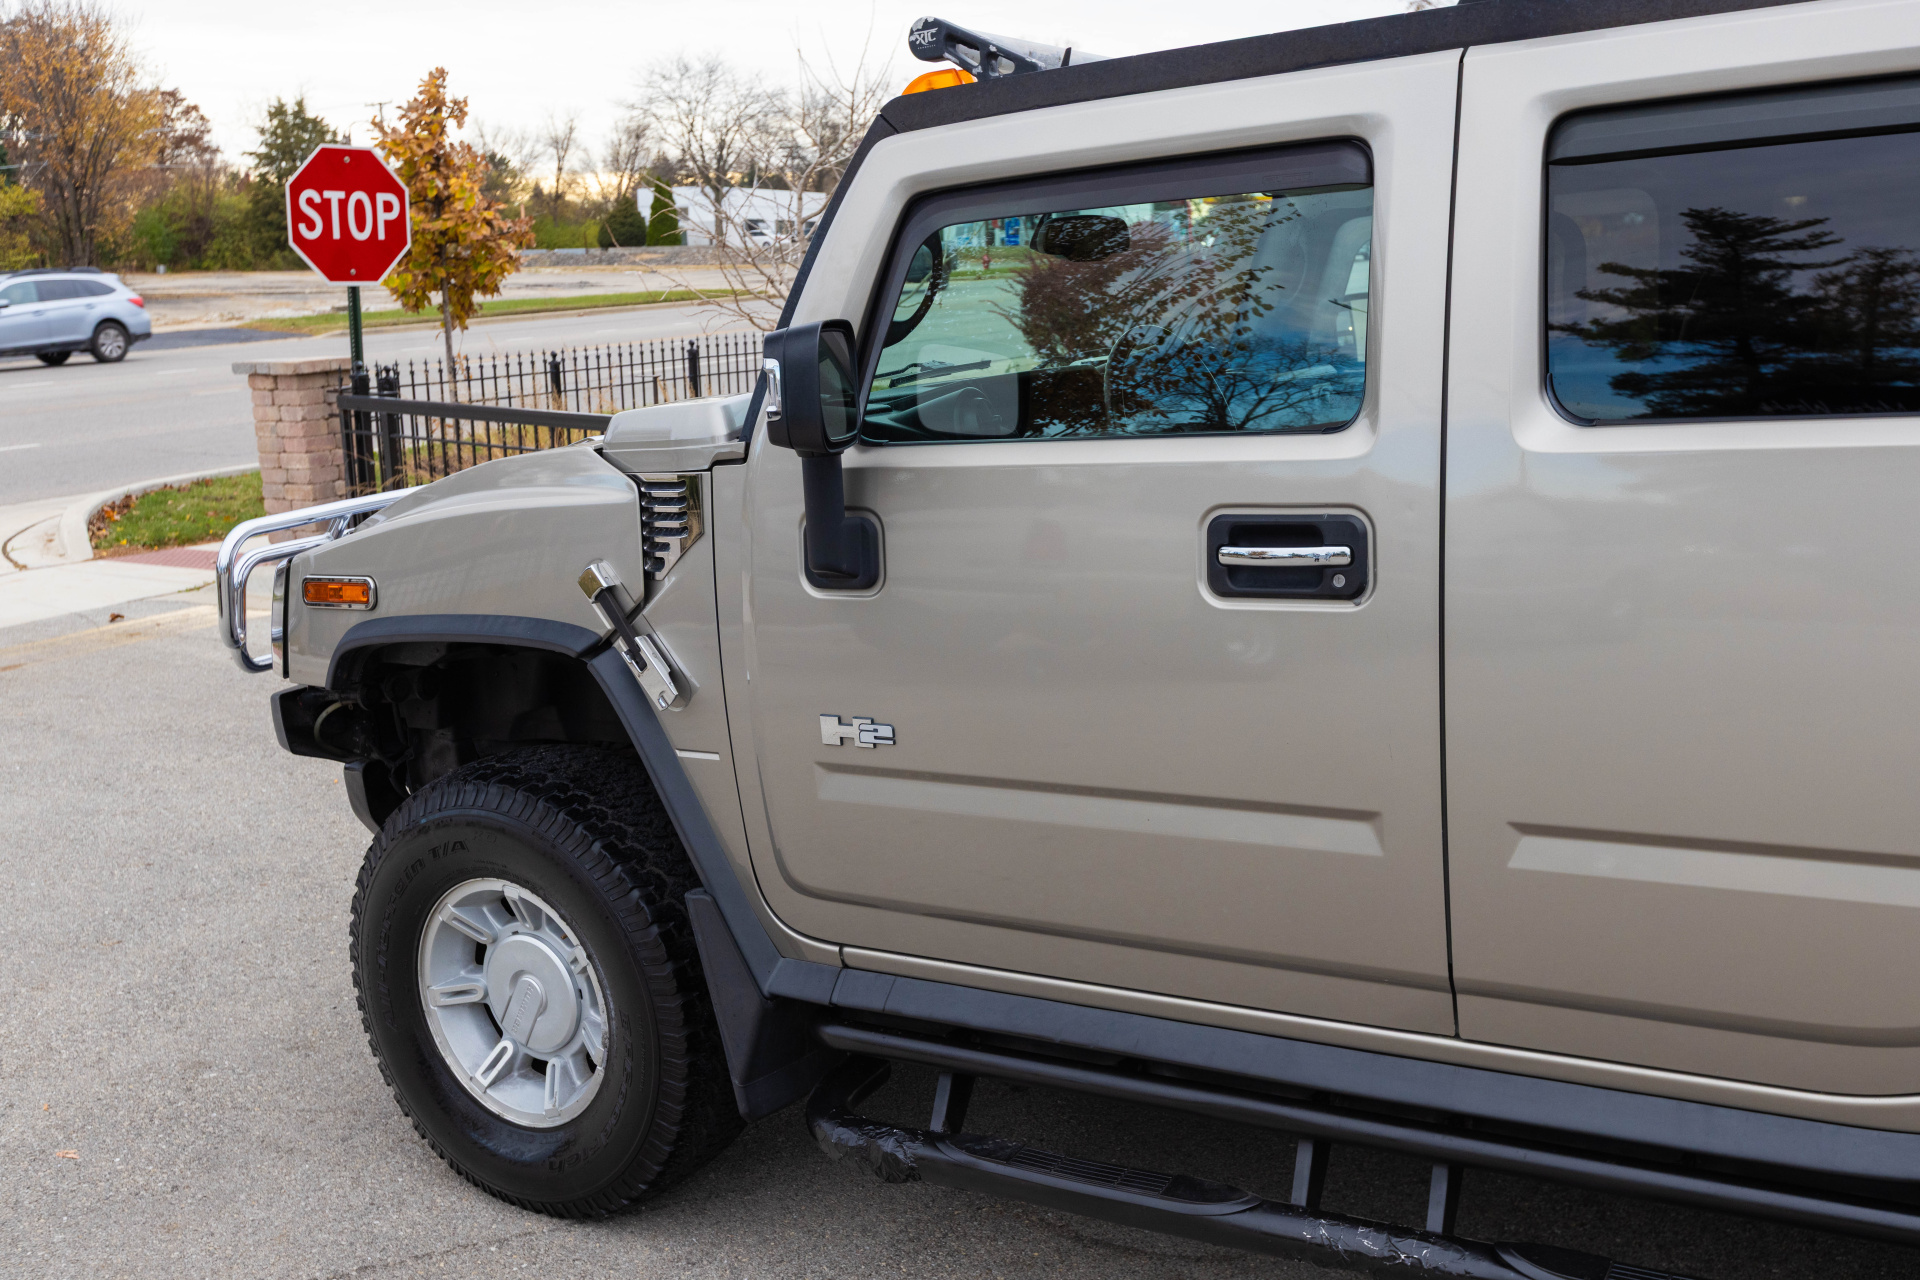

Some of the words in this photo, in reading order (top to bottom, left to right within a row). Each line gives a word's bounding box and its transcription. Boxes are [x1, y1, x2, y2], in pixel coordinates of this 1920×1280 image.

[298, 188, 401, 241] STOP
[820, 714, 896, 749] H2
[427, 839, 470, 863] T/A
[510, 983, 535, 1034] HUMMER
